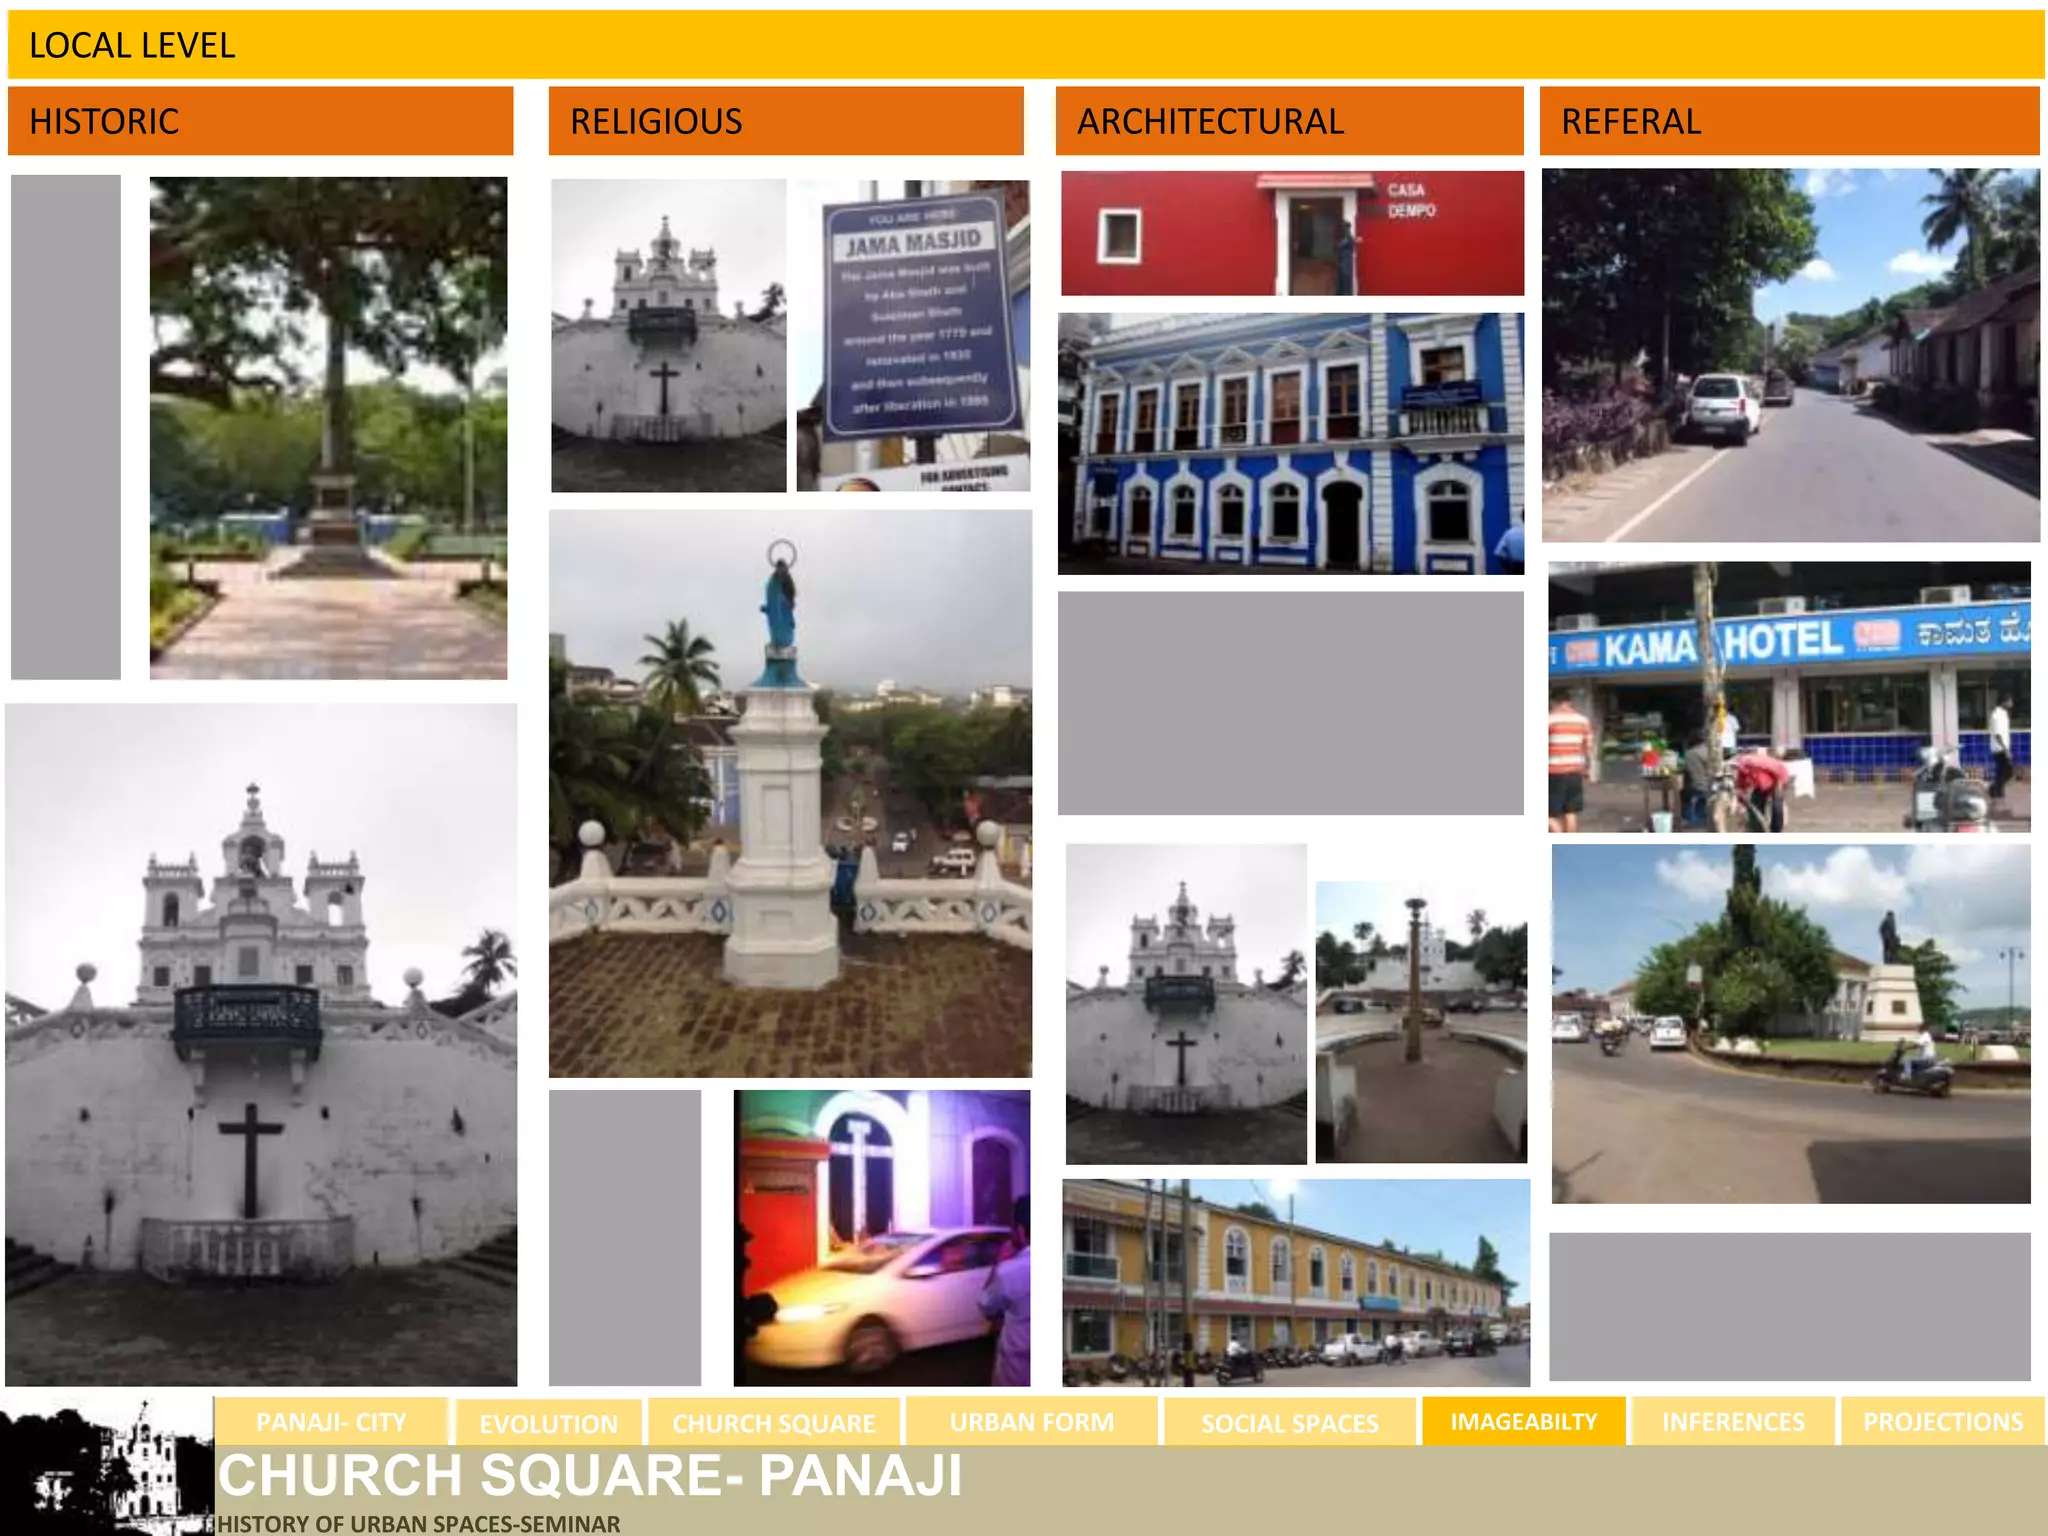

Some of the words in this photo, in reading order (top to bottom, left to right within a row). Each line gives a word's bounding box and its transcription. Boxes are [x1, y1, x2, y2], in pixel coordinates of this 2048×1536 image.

[1387, 183, 1426, 198] CASA
[868, 214, 894, 225] YOU
[897, 211, 922, 222] ARE
[1388, 203, 1438, 219] DEMPO
[846, 235, 899, 257] JAMA
[905, 228, 982, 251] MASJID
[844, 334, 885, 346] around
[888, 332, 906, 344] the
[910, 331, 935, 344] year
[969, 324, 992, 336] and
[851, 379, 874, 391] and
[853, 403, 880, 415] after
[883, 398, 941, 412] liberation
[1605, 628, 1699, 667] KAMA
[1723, 619, 1844, 661] HOTEL
